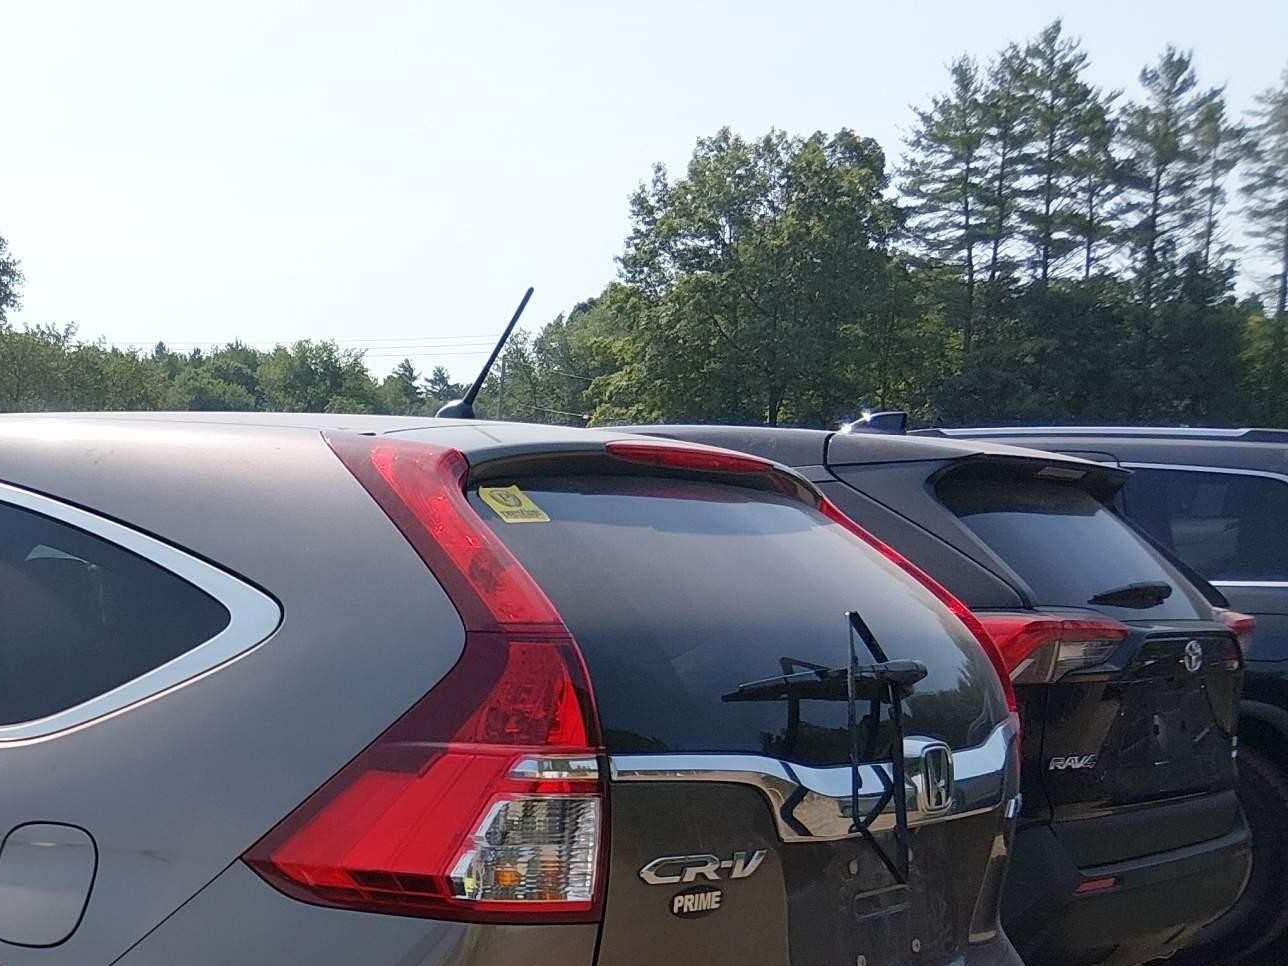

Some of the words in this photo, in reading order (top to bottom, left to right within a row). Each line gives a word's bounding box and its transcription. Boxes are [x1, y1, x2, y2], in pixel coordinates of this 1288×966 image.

[1048, 751, 1097, 770] RAV4
[639, 849, 769, 884] CR-V
[673, 890, 722, 914] PRIME
